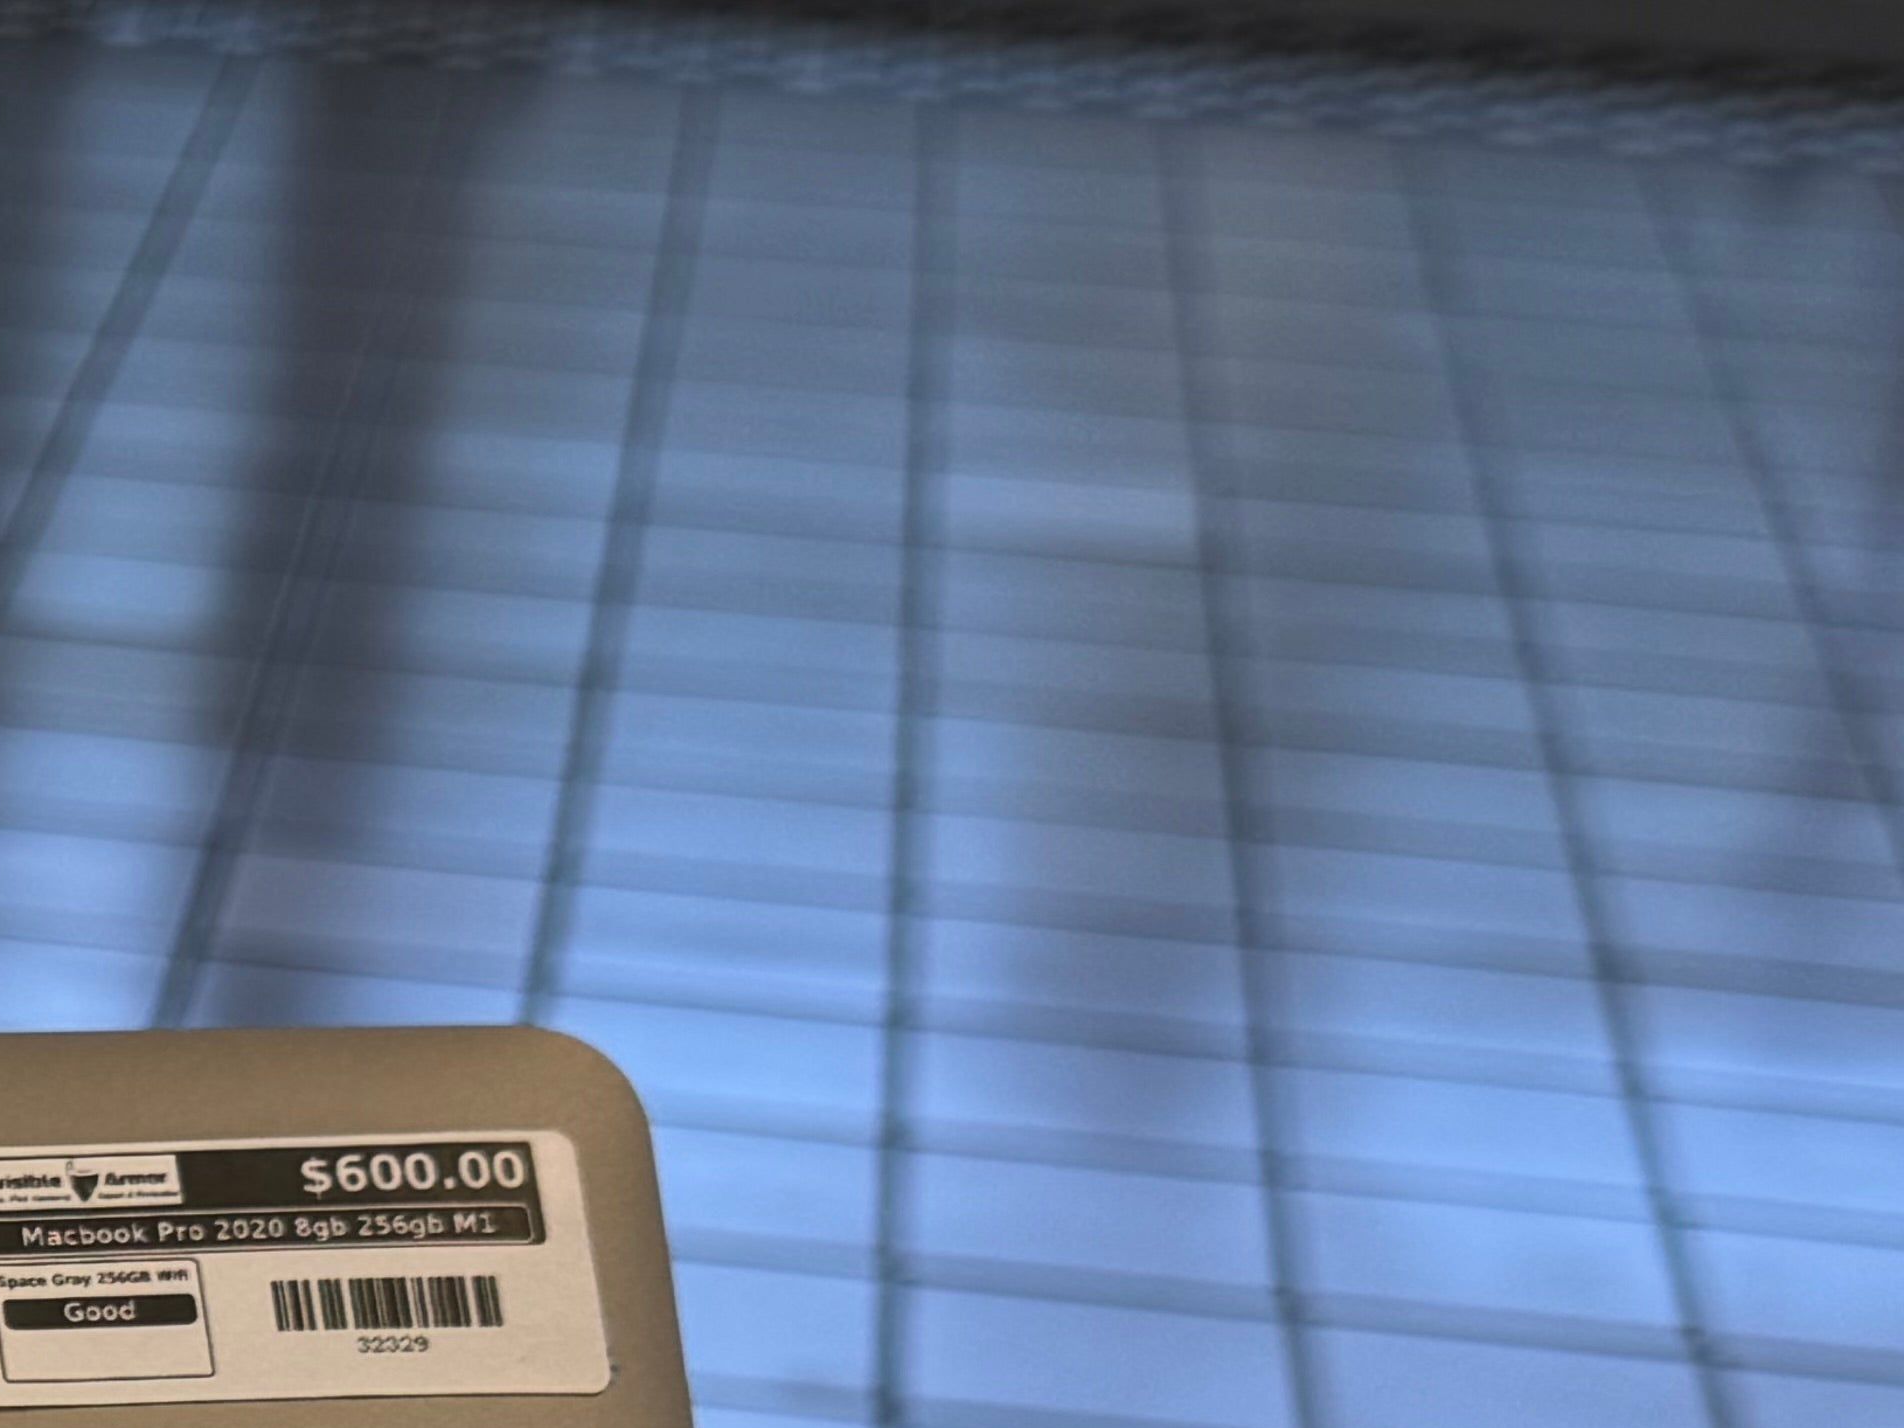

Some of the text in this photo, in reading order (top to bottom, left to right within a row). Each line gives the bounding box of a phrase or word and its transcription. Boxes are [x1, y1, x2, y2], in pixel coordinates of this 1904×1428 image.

[300, 1151, 525, 1200] $600.00
[21, 1211, 496, 1247] Macbook Pro 2020 8gb 256gb M1
[51, 1273, 91, 1288] Gray
[97, 1270, 151, 1285] 256GB
[63, 1300, 136, 1322] Good
[357, 1334, 429, 1353] 32329
